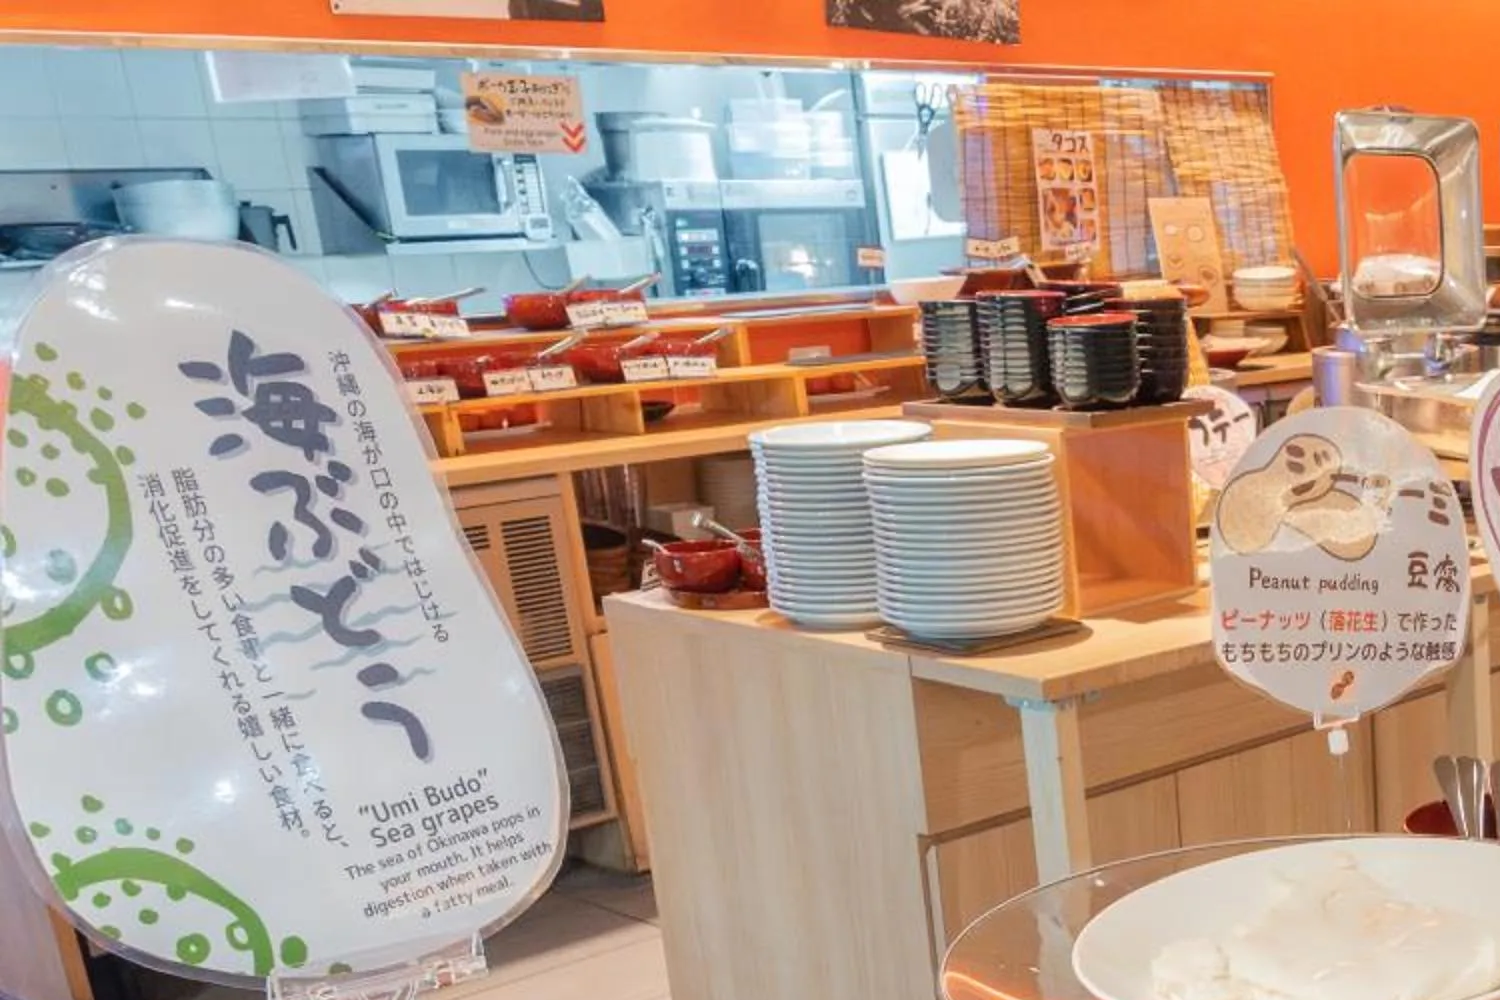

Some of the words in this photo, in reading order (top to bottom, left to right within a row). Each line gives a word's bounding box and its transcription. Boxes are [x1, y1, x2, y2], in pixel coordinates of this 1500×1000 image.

[1051, 132, 1088, 153] タコス
[328, 350, 449, 643] 沖縄の海が口の中ではじける
[178, 329, 432, 761] 海ぶどう
[1249, 565, 1311, 590] Peanut
[1318, 573, 1379, 595] pudding
[344, 864, 375, 881] The
[377, 853, 405, 869] sea
[407, 846, 423, 861] of
[426, 824, 490, 853] Okinawa
[492, 810, 525, 833] pops
[526, 805, 542, 819] in
[370, 822, 415, 848] Sea
[421, 794, 500, 837] grapes
[362, 883, 435, 918] digestion
[436, 870, 475, 891] when
[477, 856, 519, 876] taken
[520, 841, 552, 862] with
[380, 871, 412, 893] your
[416, 851, 469, 877] mouth.
[470, 845, 485, 860] It
[485, 832, 526, 855] helps
